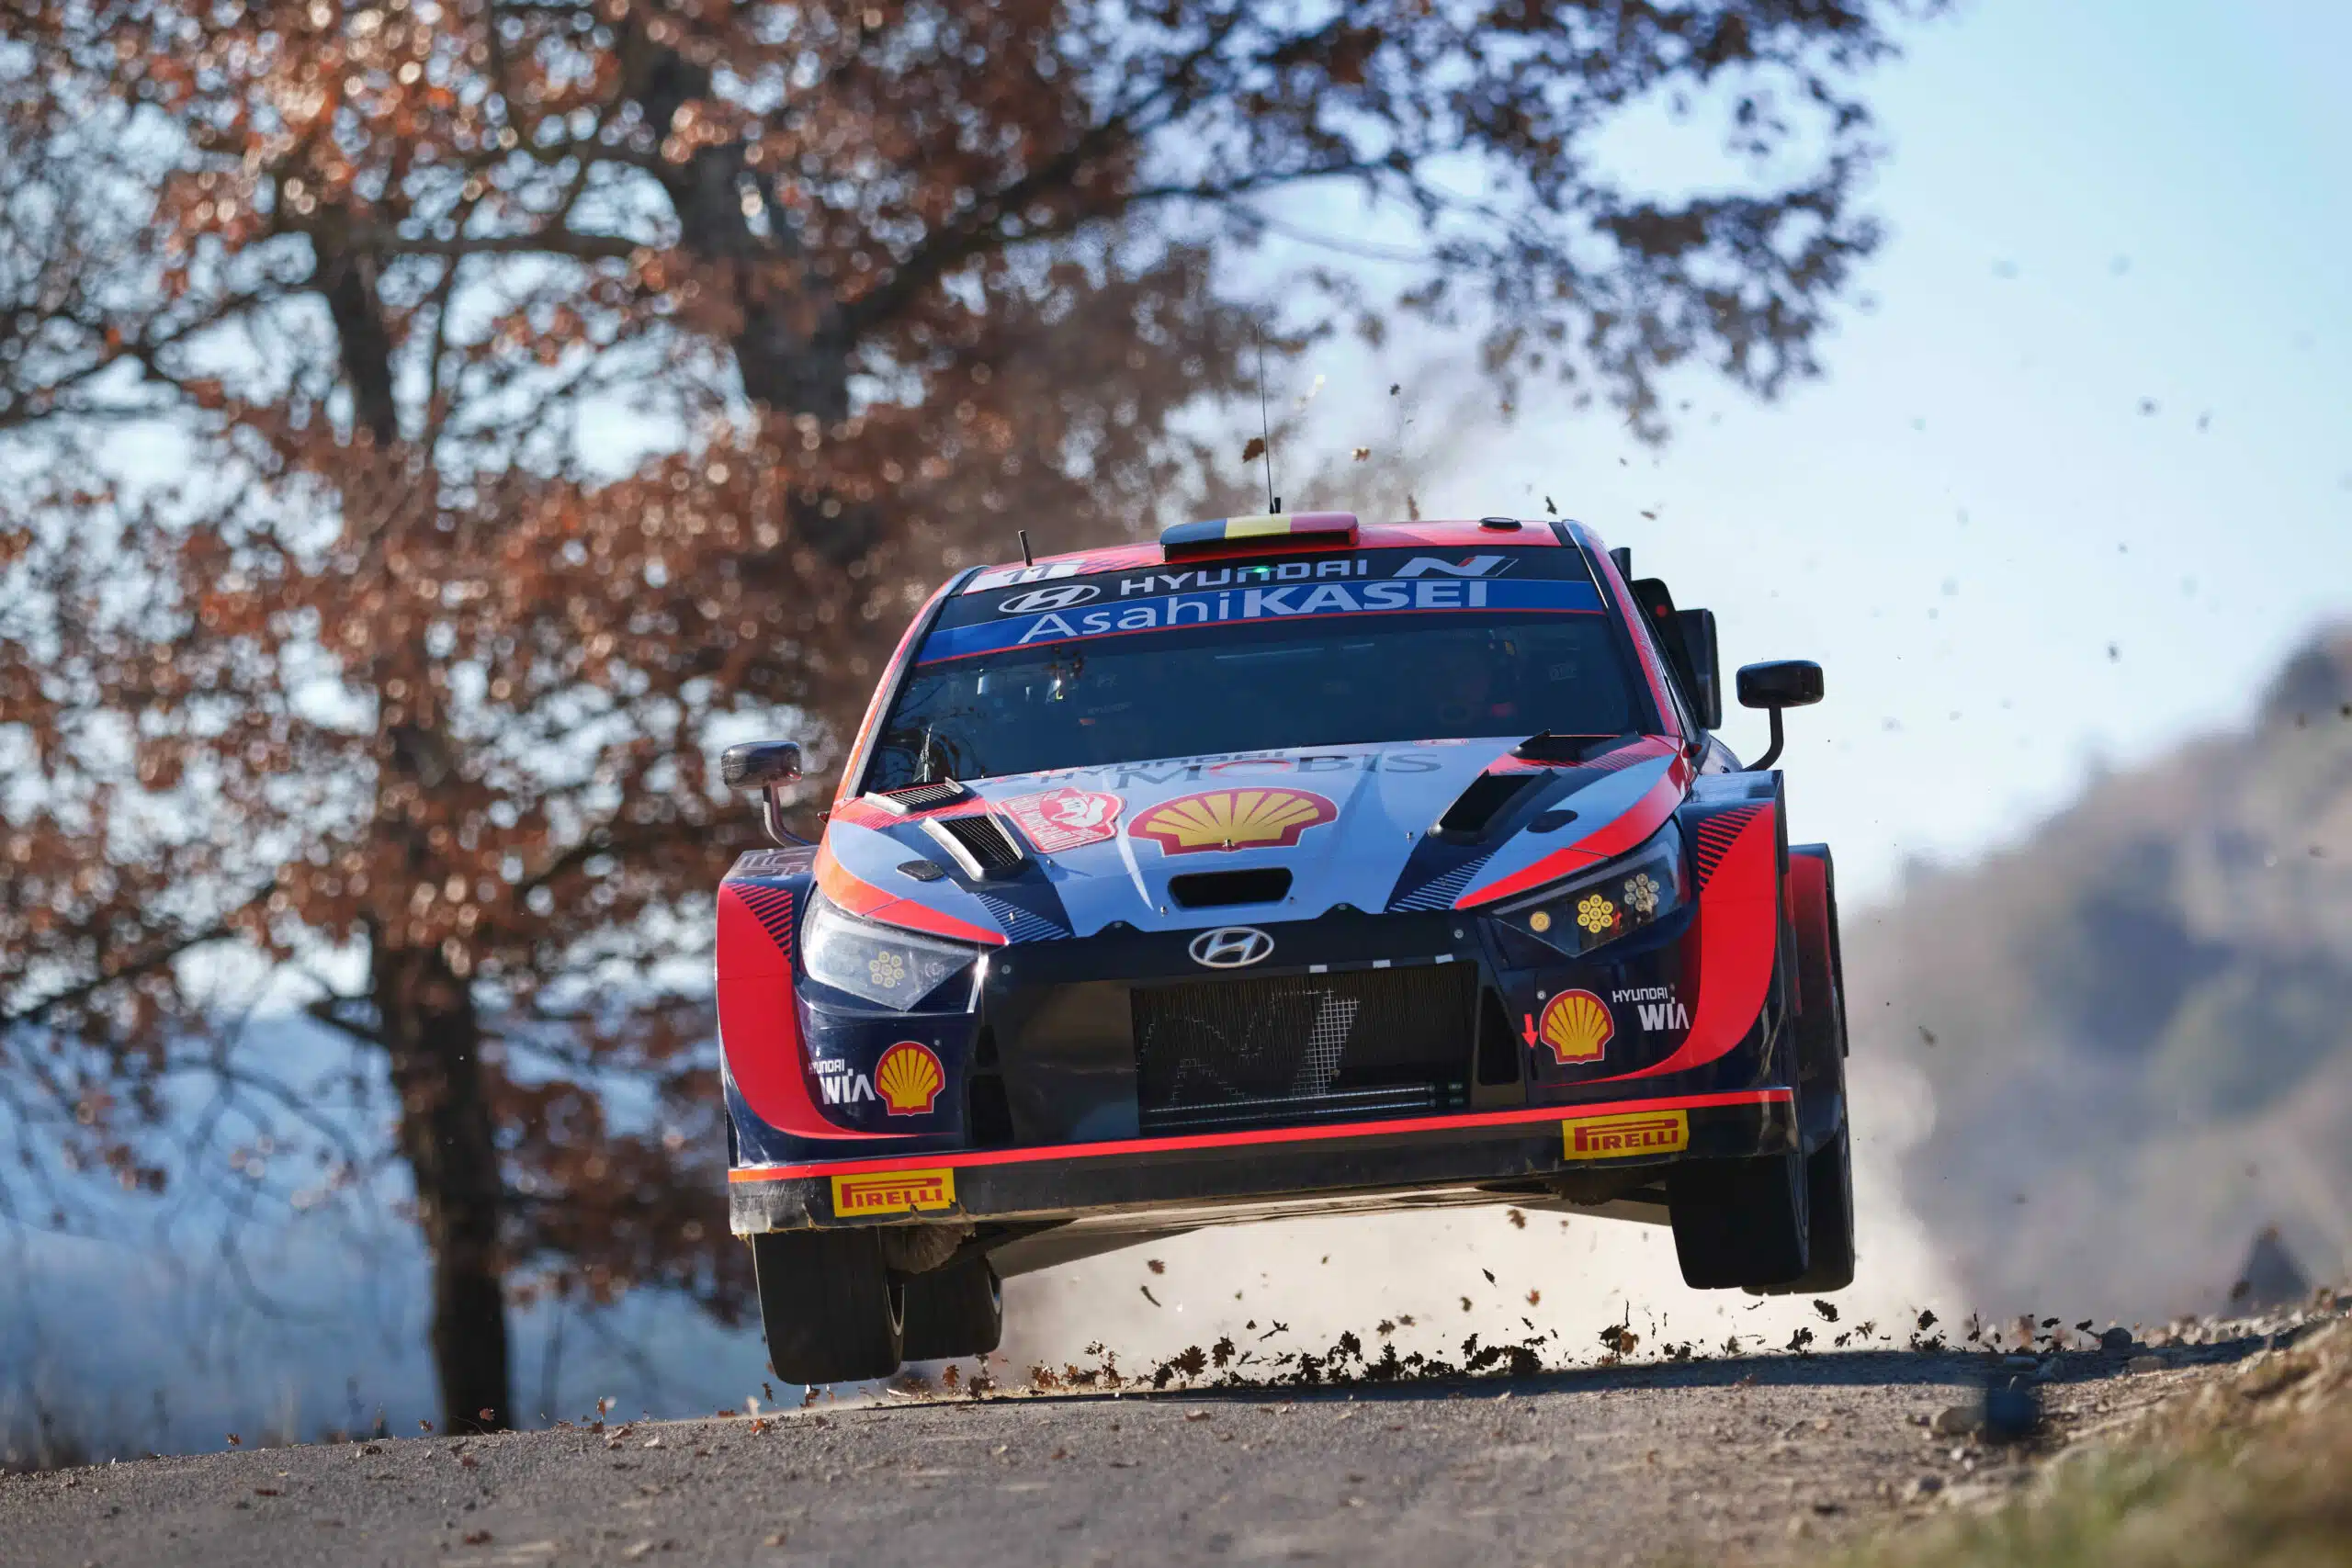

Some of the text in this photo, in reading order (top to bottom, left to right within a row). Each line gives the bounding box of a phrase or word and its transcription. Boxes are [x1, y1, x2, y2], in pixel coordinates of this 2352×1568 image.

[1120, 558, 1368, 596] HYUNDAI
[1017, 581, 1487, 644] AsahiKASEI
[1112, 753, 1442, 790] MOBIS
[1611, 987, 1668, 1003] HYUNDAI
[1637, 997, 1690, 1032] WIA
[808, 1058, 845, 1076] HYUNDAI
[820, 1068, 876, 1105] WIA
[1573, 1118, 1679, 1152] PIRELLI
[841, 1177, 944, 1209] PIRELLI
